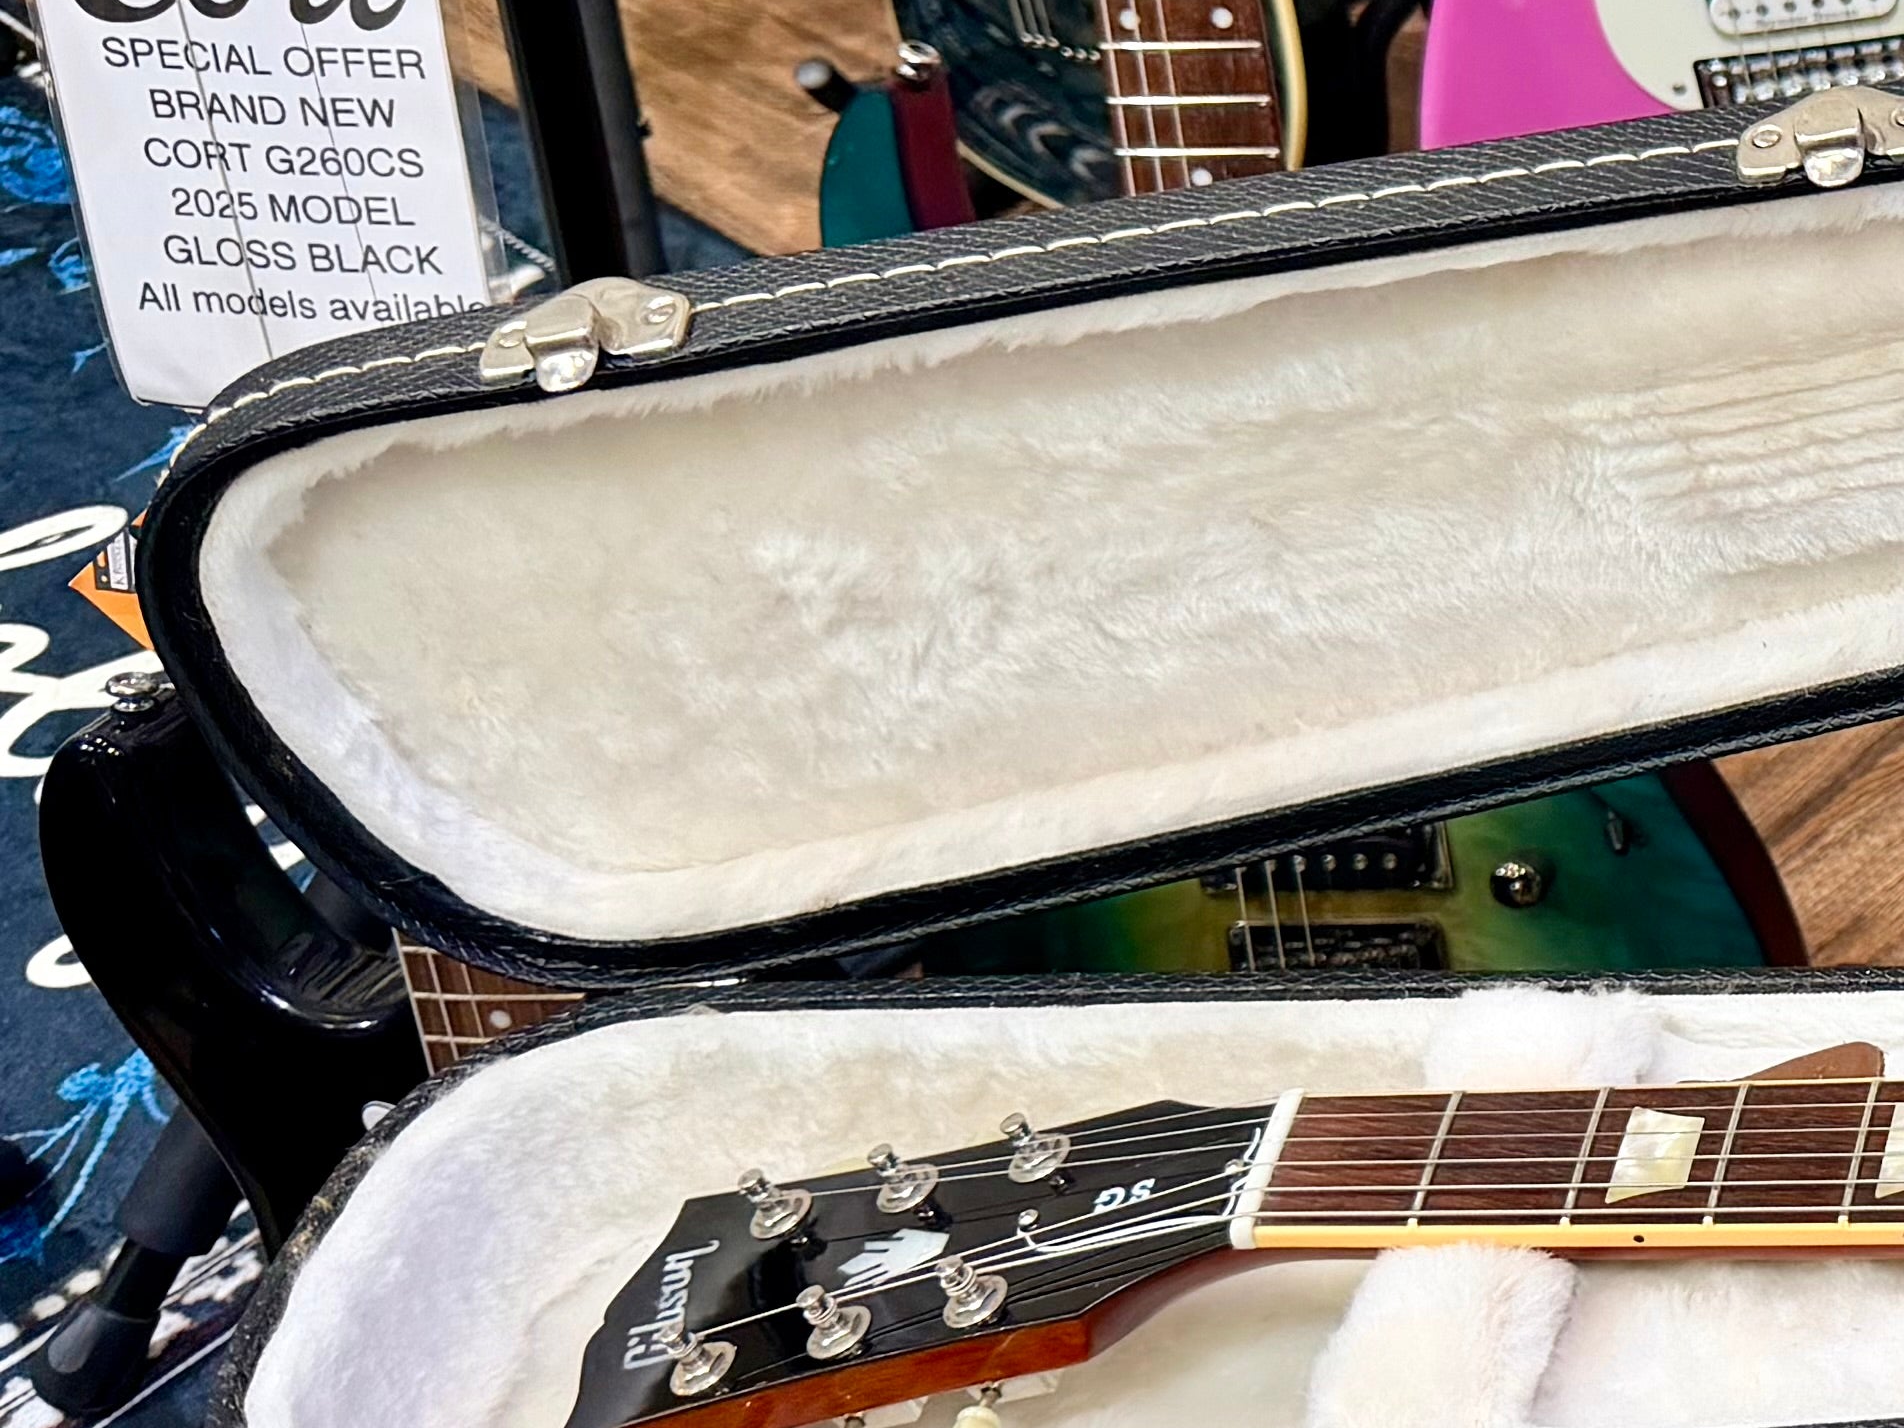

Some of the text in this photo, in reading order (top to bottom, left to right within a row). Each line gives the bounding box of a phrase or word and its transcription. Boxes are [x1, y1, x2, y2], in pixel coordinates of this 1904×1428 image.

[102, 36, 427, 80] SPECIAL OFFER
[149, 88, 396, 128] BRAND NEW
[143, 137, 425, 178] CORT G260CS
[171, 187, 416, 226] 2025 MODEL
[163, 234, 443, 276] GLOSS BLACK
[138, 282, 180, 312] All
[192, 288, 317, 320] models
[1092, 1178, 1156, 1213] SG
